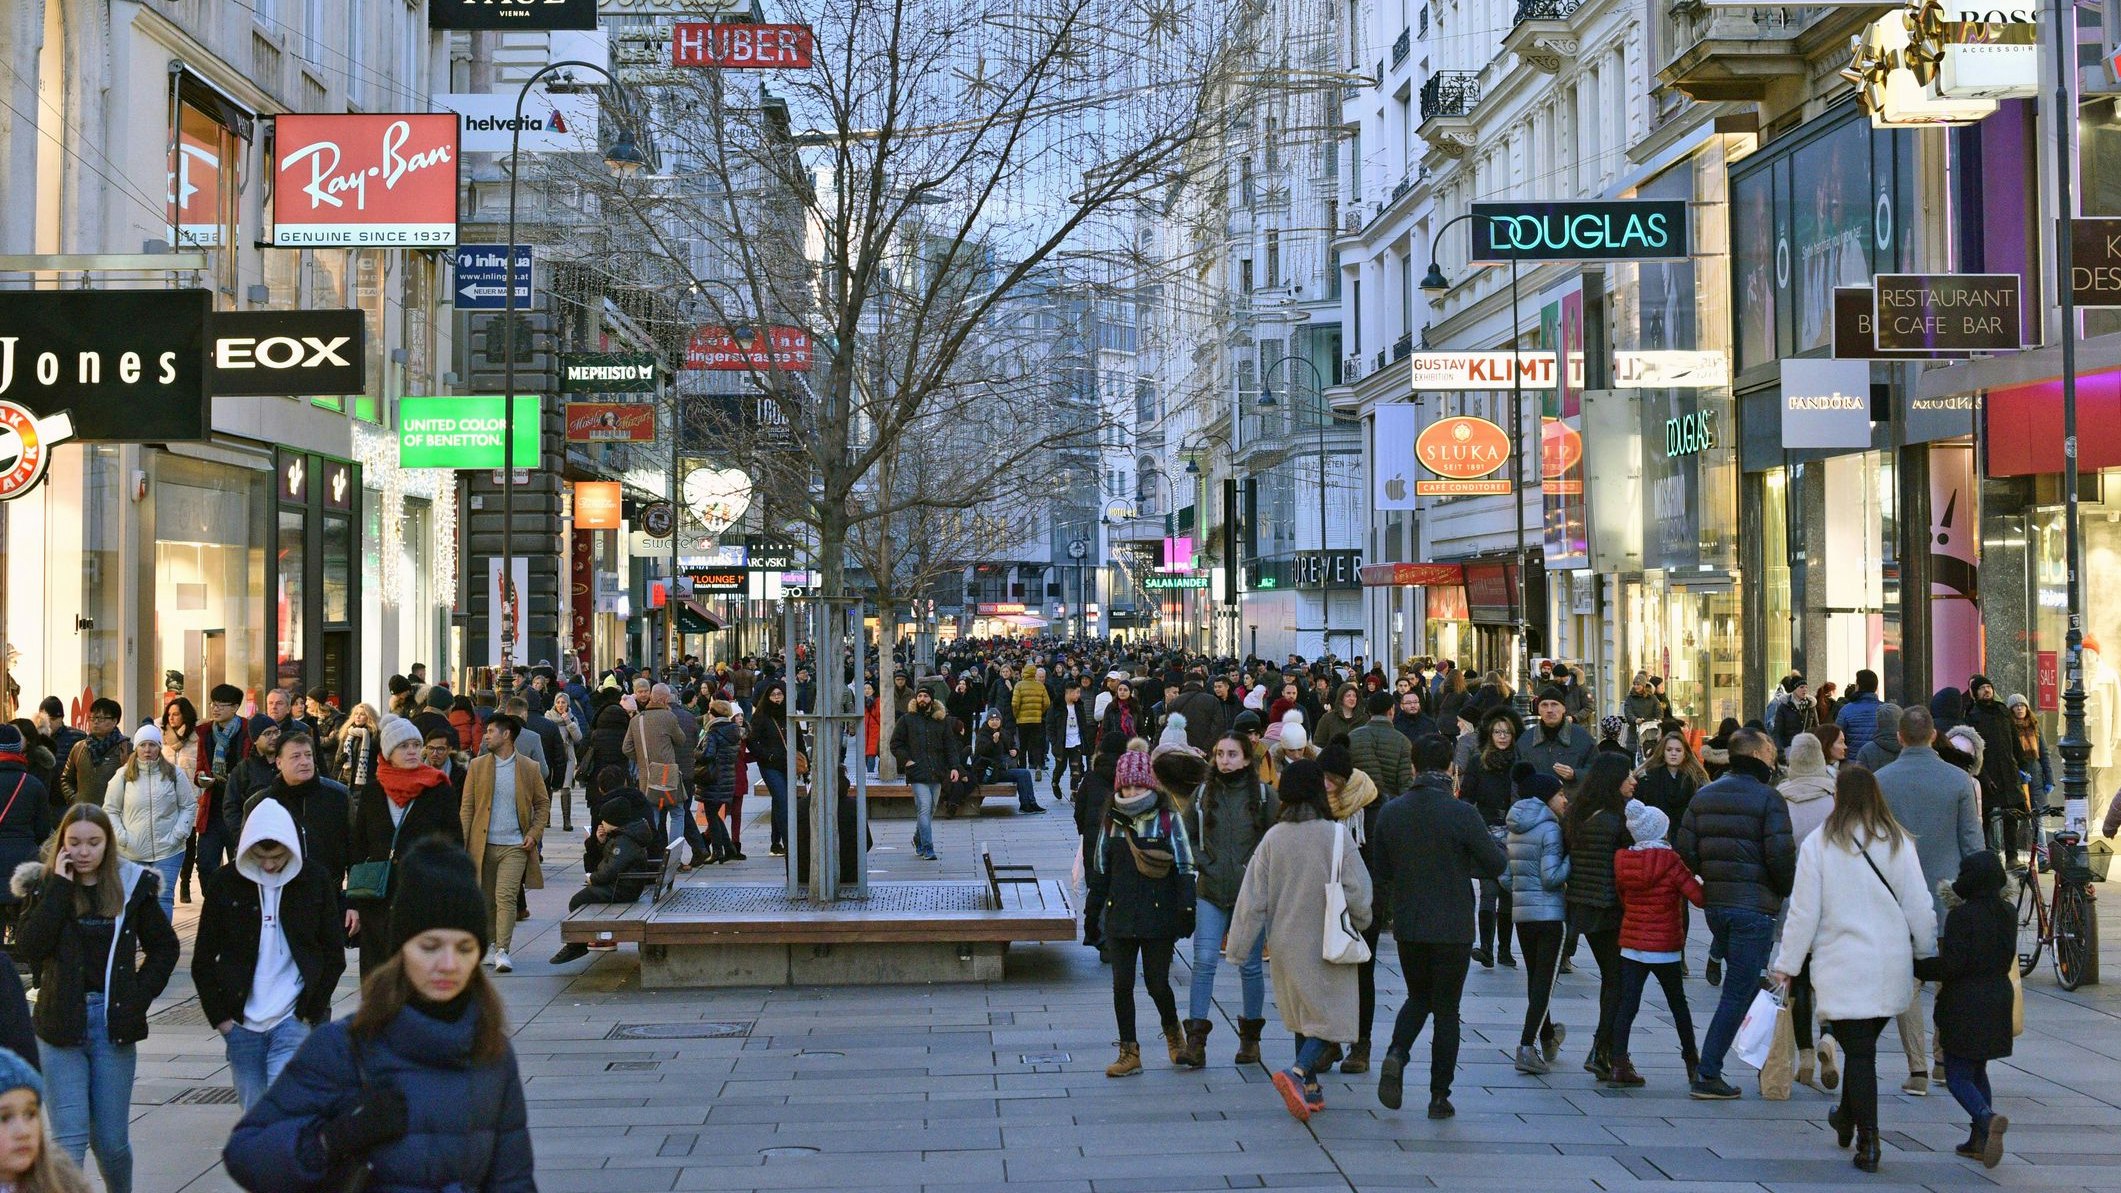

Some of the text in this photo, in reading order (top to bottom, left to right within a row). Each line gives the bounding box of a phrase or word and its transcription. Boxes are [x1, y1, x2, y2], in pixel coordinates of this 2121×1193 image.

[680, 28, 798, 61] HUBER
[1962, 46, 2034, 54] ACCESSOIR
[281, 232, 451, 242] GENUINE SINCE 1937
[1490, 213, 1668, 250] DOUGLAS
[1882, 289, 2014, 307] RESTAURANT
[1894, 316, 2004, 334] CAFE BAR
[0, 336, 177, 394] Jones
[568, 365, 637, 380] MEPHISTO
[1414, 359, 1466, 370] GUSTAV
[1468, 358, 1555, 381] KLIMT
[1414, 373, 1454, 382] EXHIBITION
[1789, 392, 1864, 410] PANDORA
[404, 419, 456, 432] UNITED
[1666, 409, 1710, 458] DOUGLAS
[404, 434, 503, 447] OF BENETTON.
[1427, 445, 1499, 462] SLUKA
[1423, 481, 1505, 491] CAFÉ CONDITOREI
[2040, 669, 2056, 686] SALE
